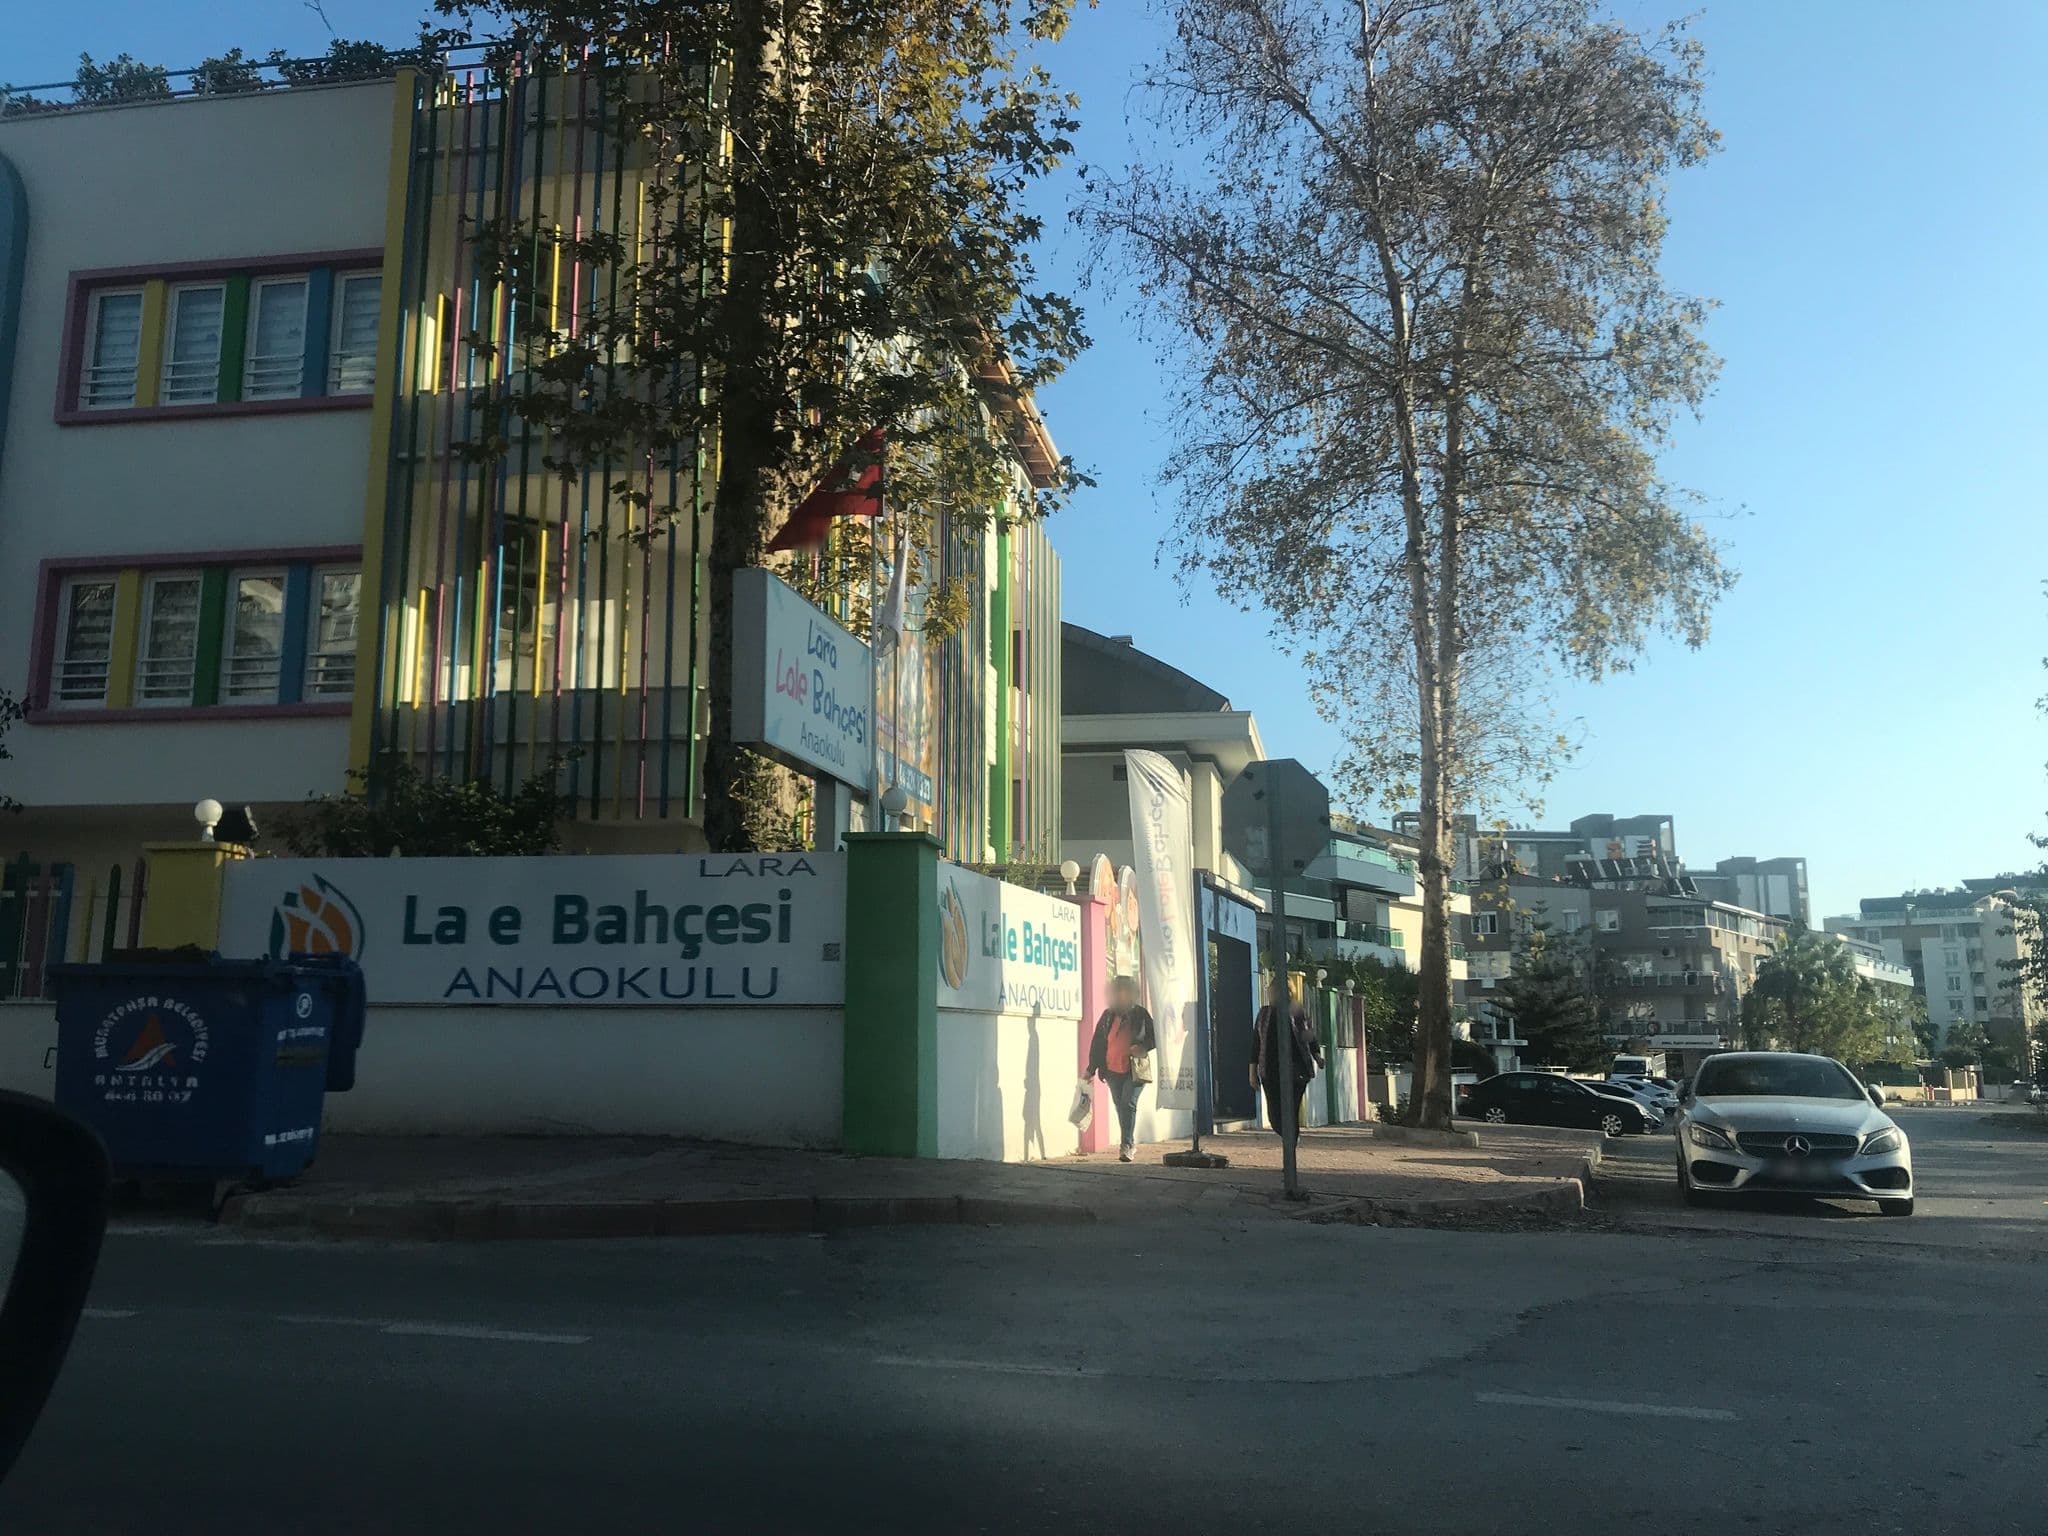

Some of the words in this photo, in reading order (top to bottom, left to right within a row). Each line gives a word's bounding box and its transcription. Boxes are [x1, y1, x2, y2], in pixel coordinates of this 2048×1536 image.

[807, 619, 837, 670] Lara
[776, 648, 808, 705] Lale
[800, 722, 846, 768] Anaokulu
[699, 857, 817, 878] LARA
[551, 888, 792, 961] Bahçesi
[1052, 903, 1076, 923] LARA
[981, 910, 1017, 962] Lale
[1023, 919, 1078, 981] Bahçesi
[442, 966, 780, 1000] ANAOKULU
[998, 983, 1072, 1012] ANAOKULU
[94, 1074, 200, 1088] ANTALYA
